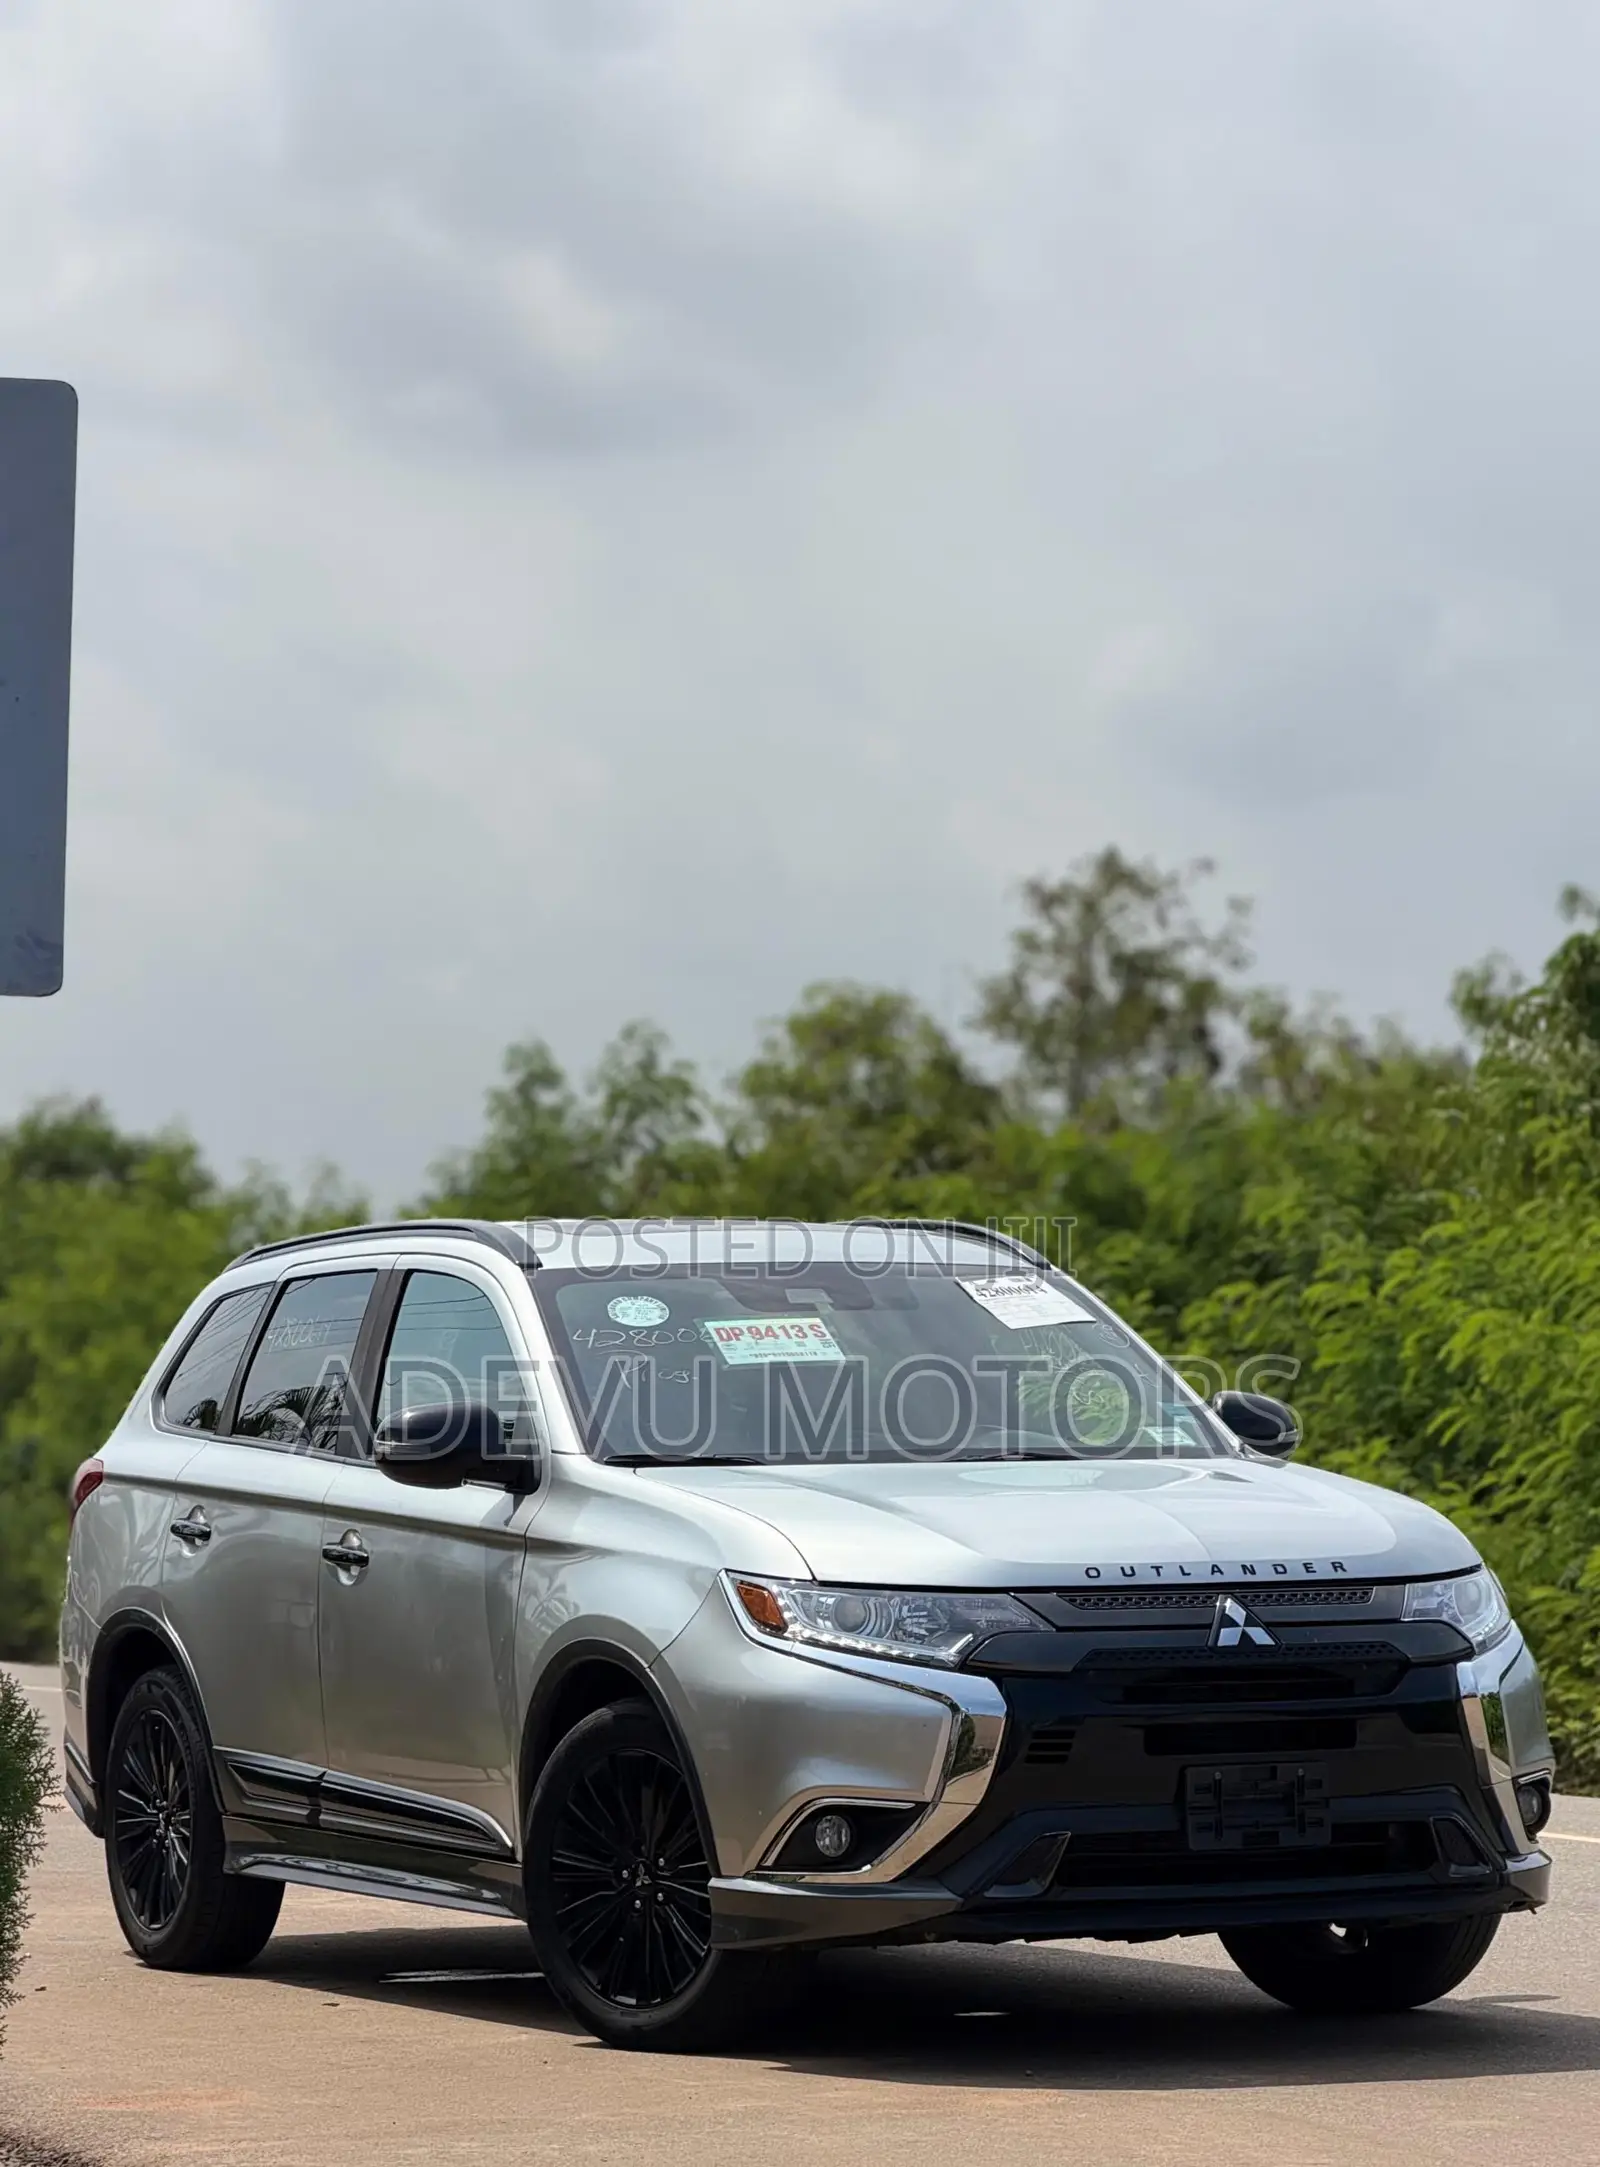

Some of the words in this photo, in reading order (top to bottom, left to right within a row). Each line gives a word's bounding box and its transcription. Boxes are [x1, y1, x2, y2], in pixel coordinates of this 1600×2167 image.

[714, 1327, 745, 1342] DP
[746, 1324, 809, 1341] 9413
[1084, 1560, 1348, 1580] OUTLANDER
